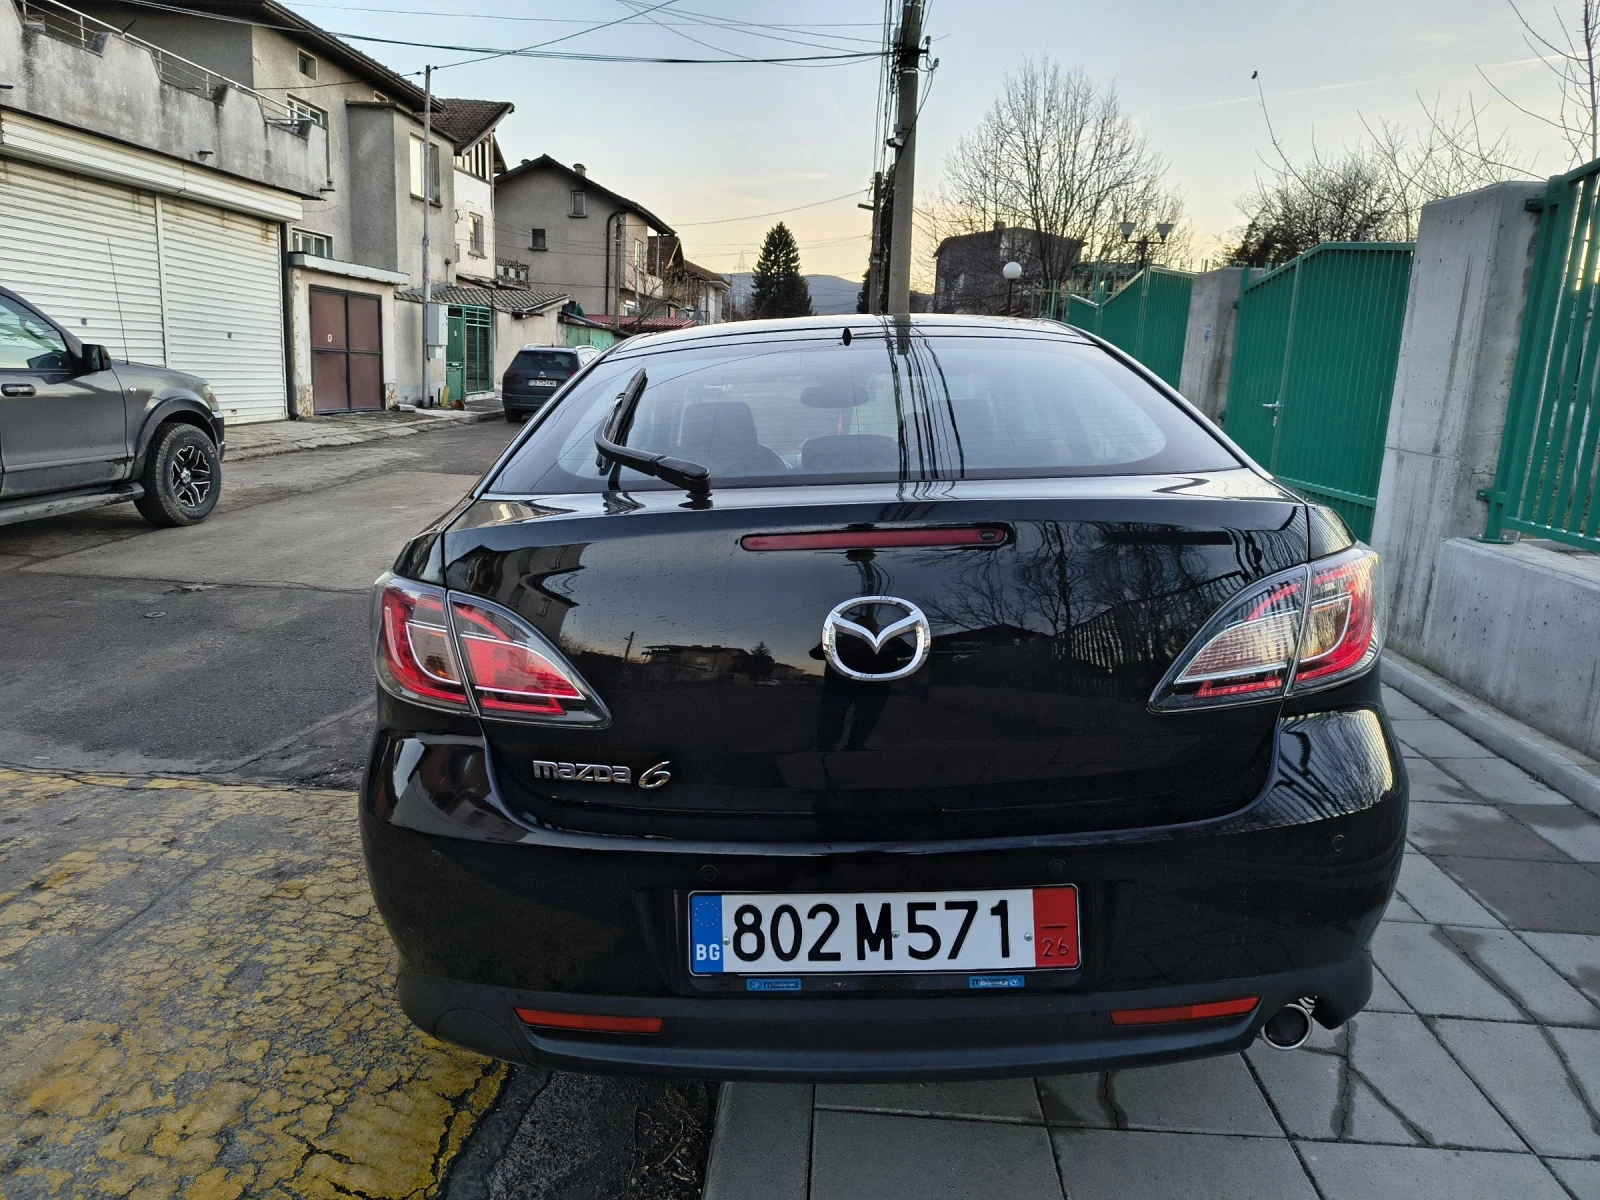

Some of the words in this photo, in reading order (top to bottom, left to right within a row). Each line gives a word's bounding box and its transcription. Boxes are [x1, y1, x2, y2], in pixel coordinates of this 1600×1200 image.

[638, 760, 671, 789] 6
[696, 943, 721, 961] BG
[1042, 938, 1069, 957] 26
